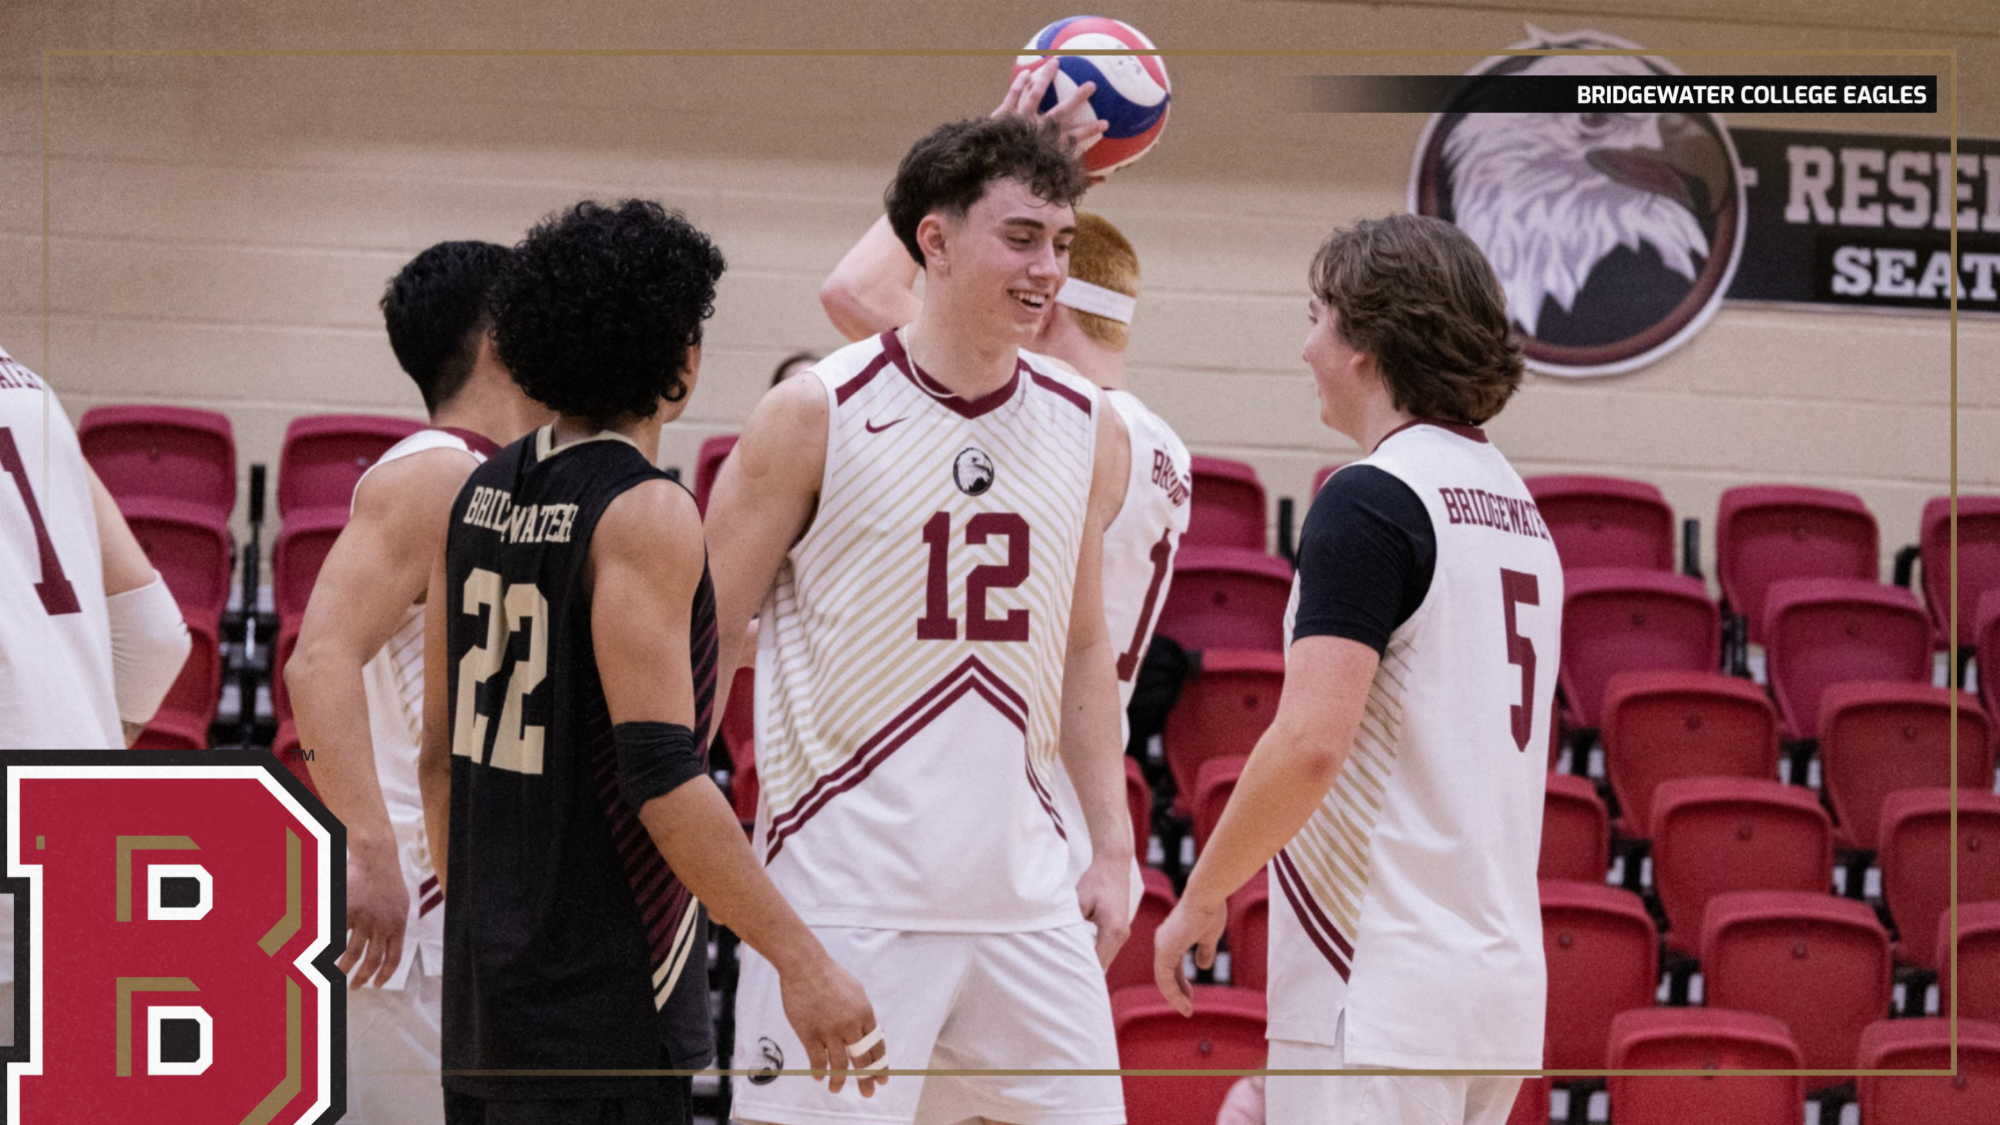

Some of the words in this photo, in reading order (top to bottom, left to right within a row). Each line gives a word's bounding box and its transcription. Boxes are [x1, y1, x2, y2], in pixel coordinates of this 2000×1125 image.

[917, 511, 1030, 642] 12
[1500, 567, 1540, 753] 5
[452, 567, 549, 775] 22
